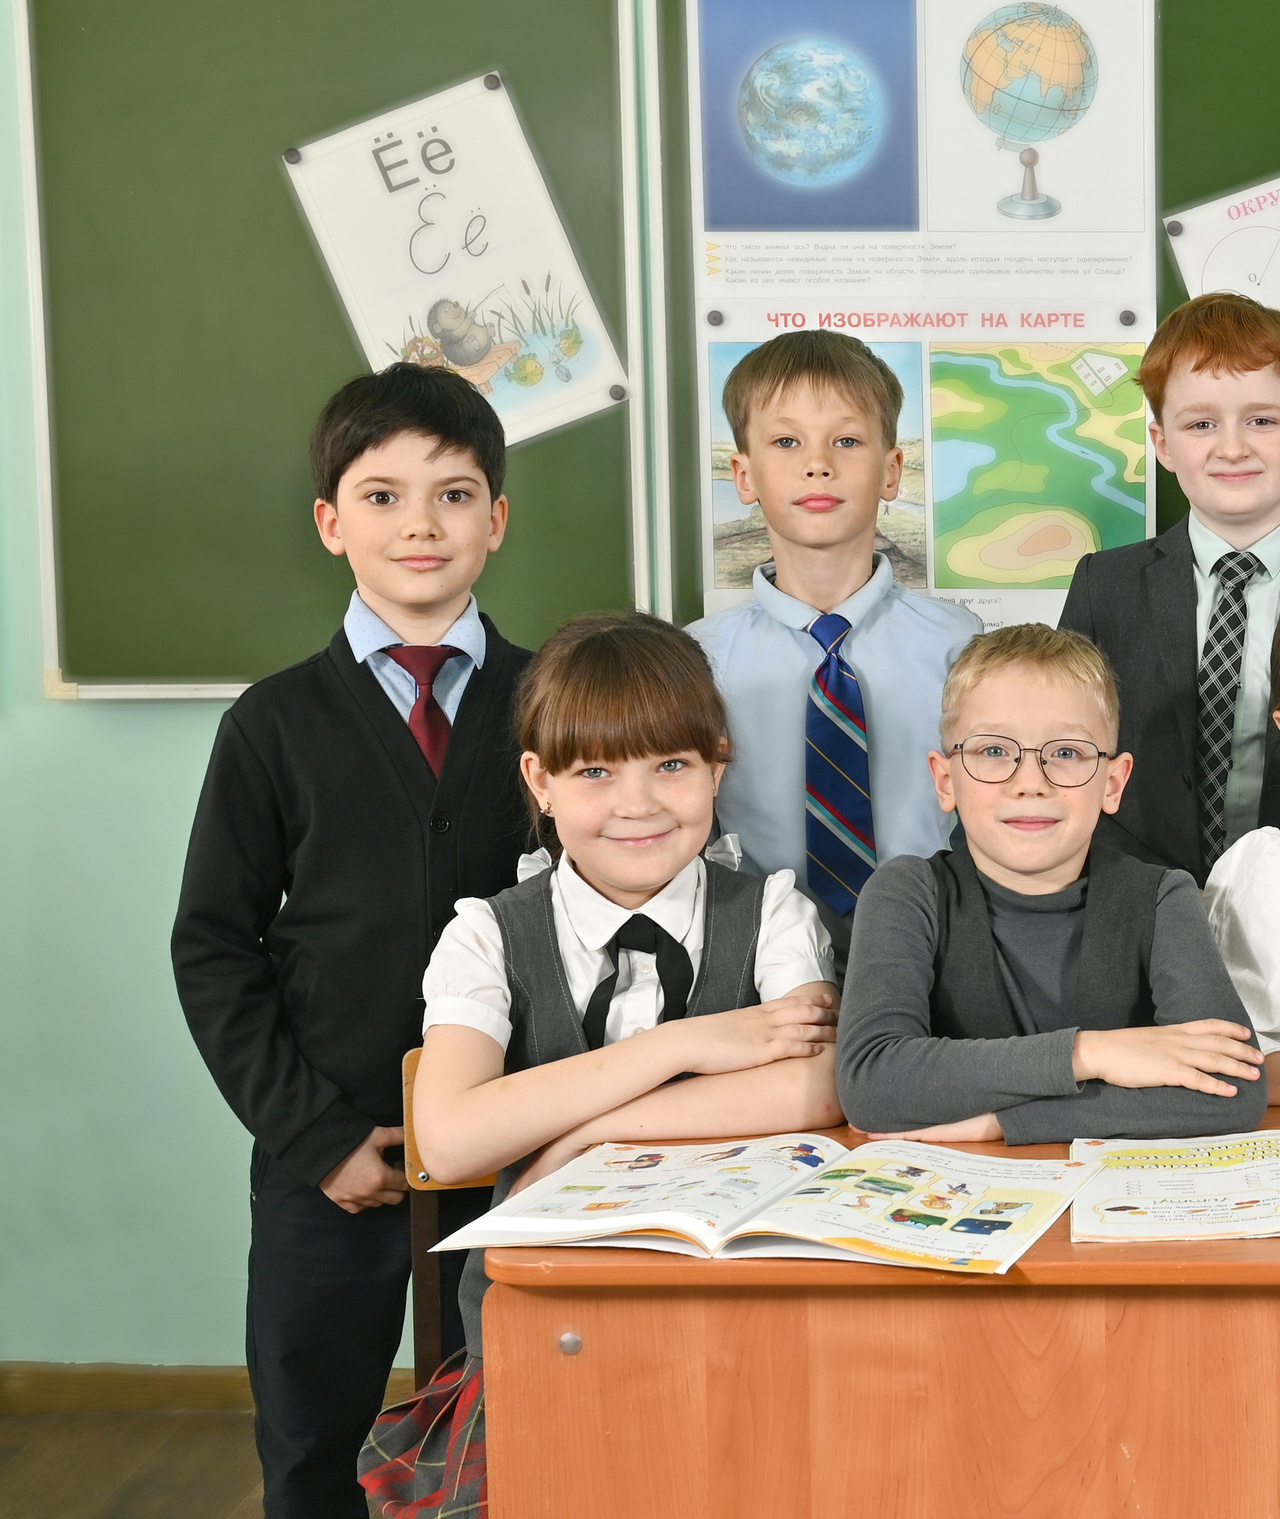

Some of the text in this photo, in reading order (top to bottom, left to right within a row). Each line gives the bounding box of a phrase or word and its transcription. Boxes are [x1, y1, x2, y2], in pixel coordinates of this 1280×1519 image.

[371, 125, 456, 194] Ёё
[766, 312, 1085, 328] ЧТО ИЗОБРАЖАЮТ НА КАРТЕ
[978, 597, 1002, 605] друга?
